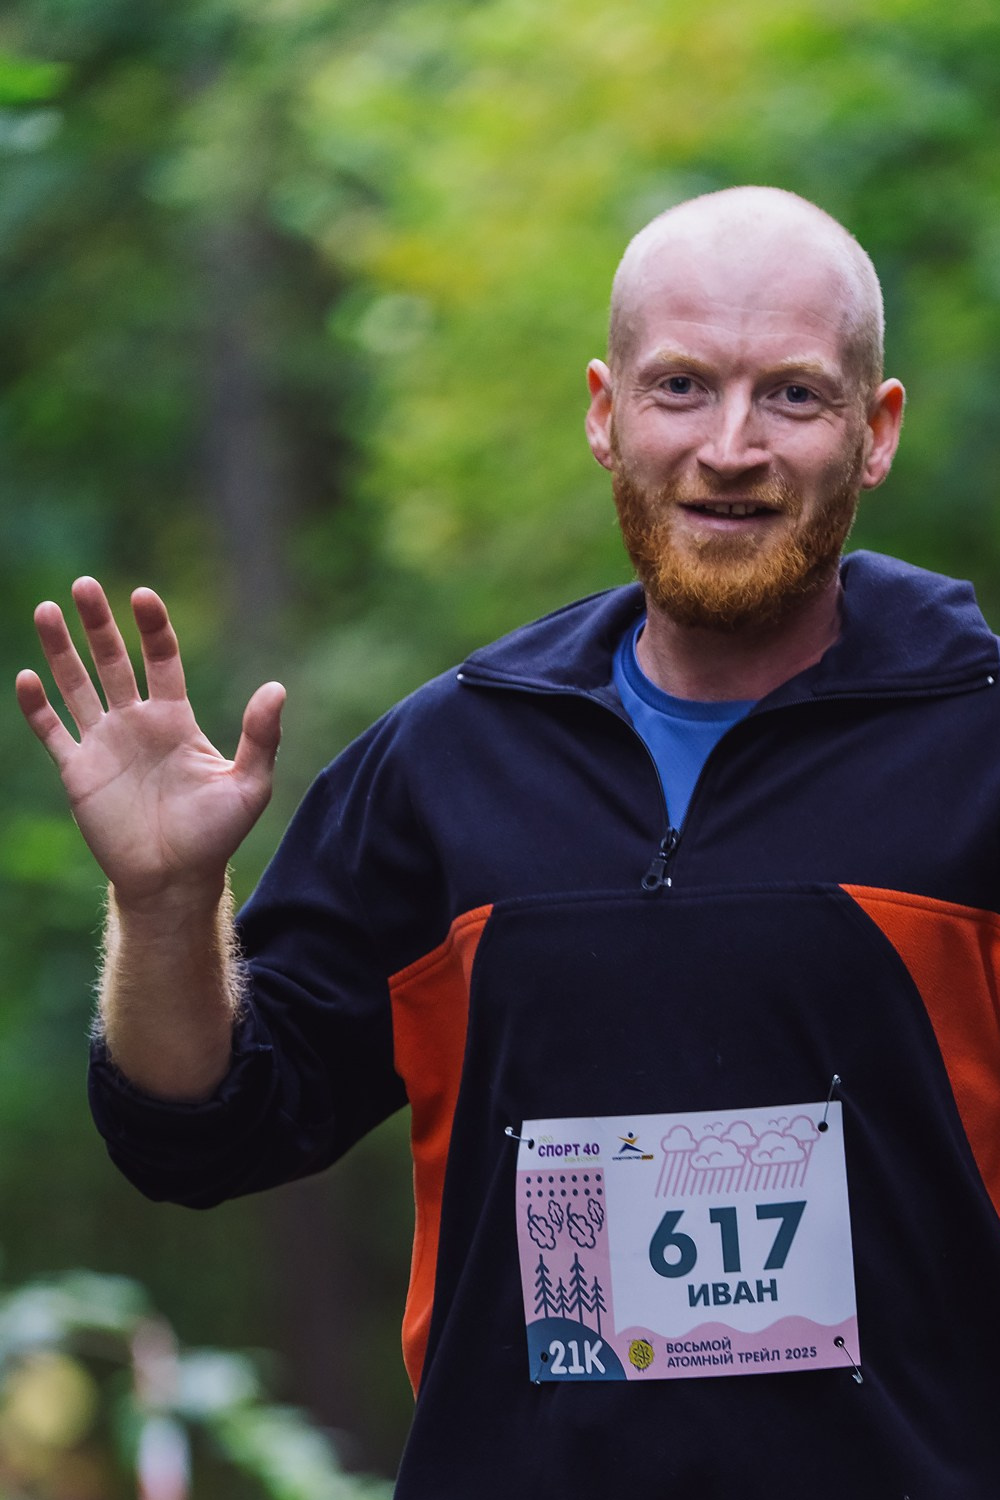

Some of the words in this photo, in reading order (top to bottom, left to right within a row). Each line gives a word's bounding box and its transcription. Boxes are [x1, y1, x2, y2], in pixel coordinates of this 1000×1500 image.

[538, 1144, 580, 1157] СПОРТ
[583, 1143, 600, 1155] 40
[649, 1200, 807, 1278] 617
[688, 1279, 778, 1307] ИВАН
[666, 1336, 732, 1353] ВОСЬМОЙ
[667, 1350, 734, 1368] АТОМНЫЙ
[737, 1347, 781, 1364] ТРЕЙЛ
[785, 1346, 817, 1360] 2025
